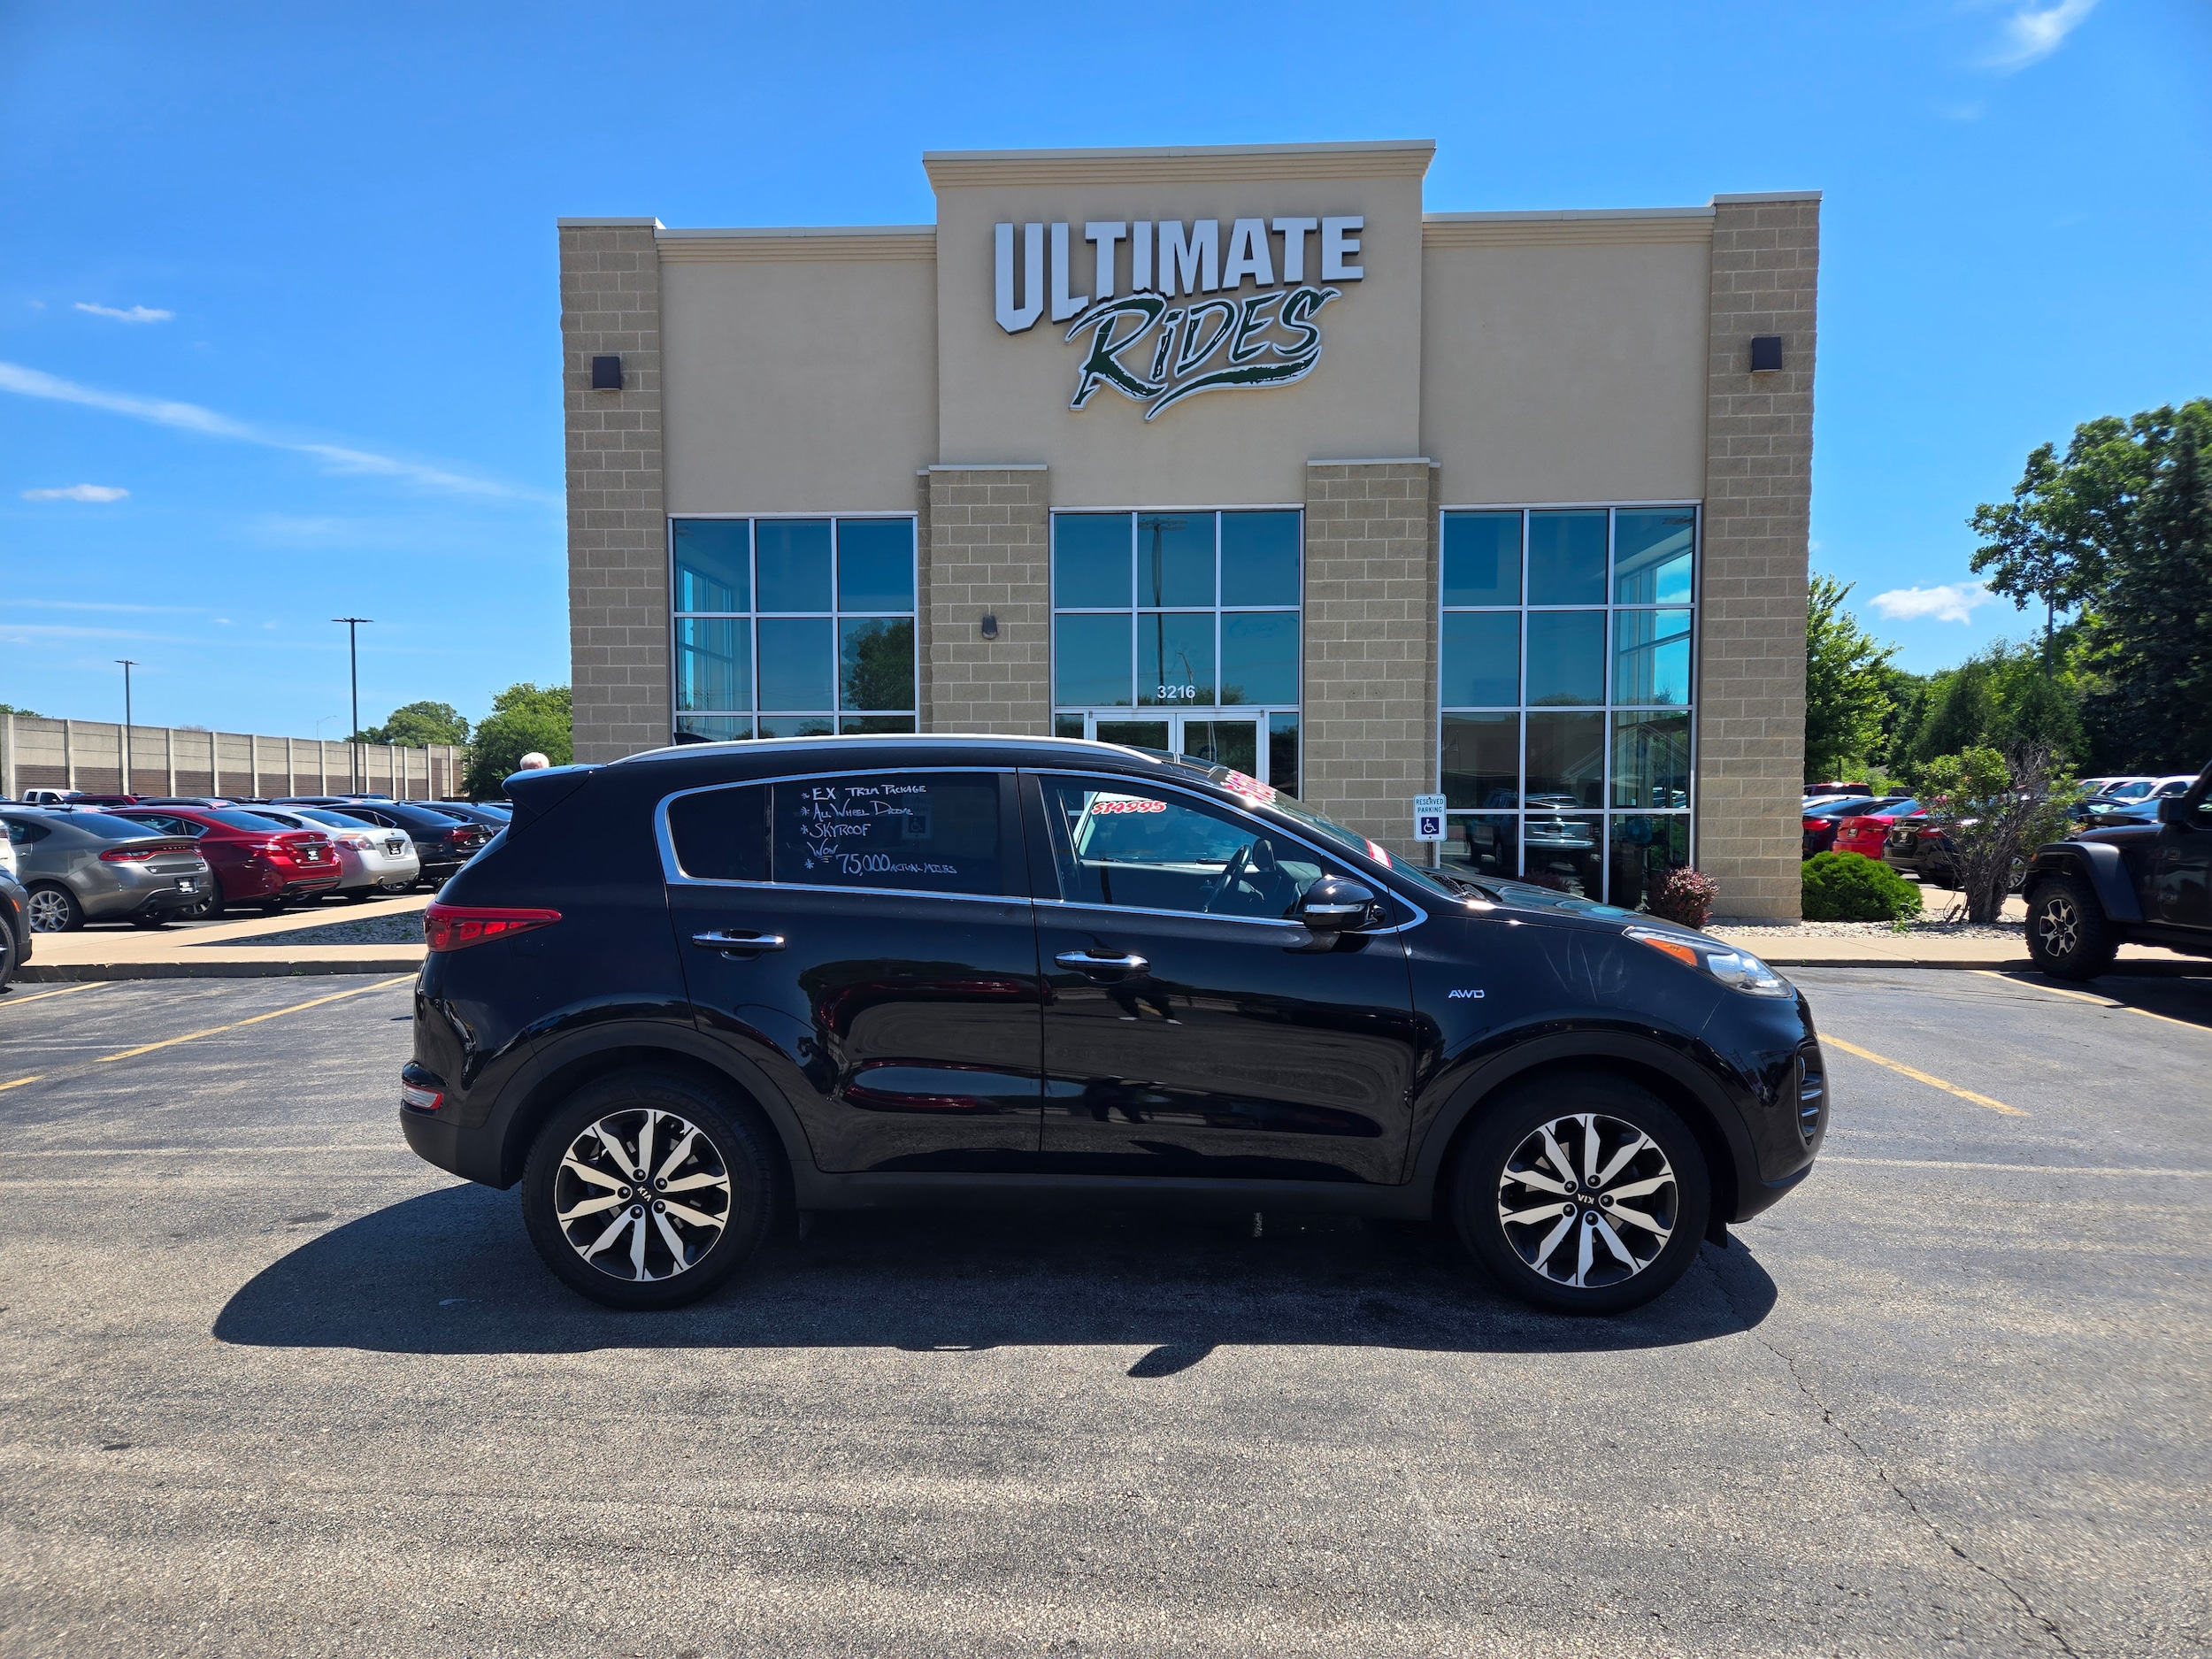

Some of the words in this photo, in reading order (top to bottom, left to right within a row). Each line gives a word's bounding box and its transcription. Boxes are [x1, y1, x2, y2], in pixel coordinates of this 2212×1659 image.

[995, 216, 1364, 334] ULTIMATE
[1157, 685, 1195, 699] 3216
[812, 787, 836, 800] EX
[1091, 800, 1167, 814] $14995
[809, 822, 872, 839] SKYROOF
[835, 854, 891, 876] 75,000
[1448, 989, 1486, 998] AWD
[637, 1186, 652, 1202] KIA
[1578, 1193, 1594, 1204] KIA
